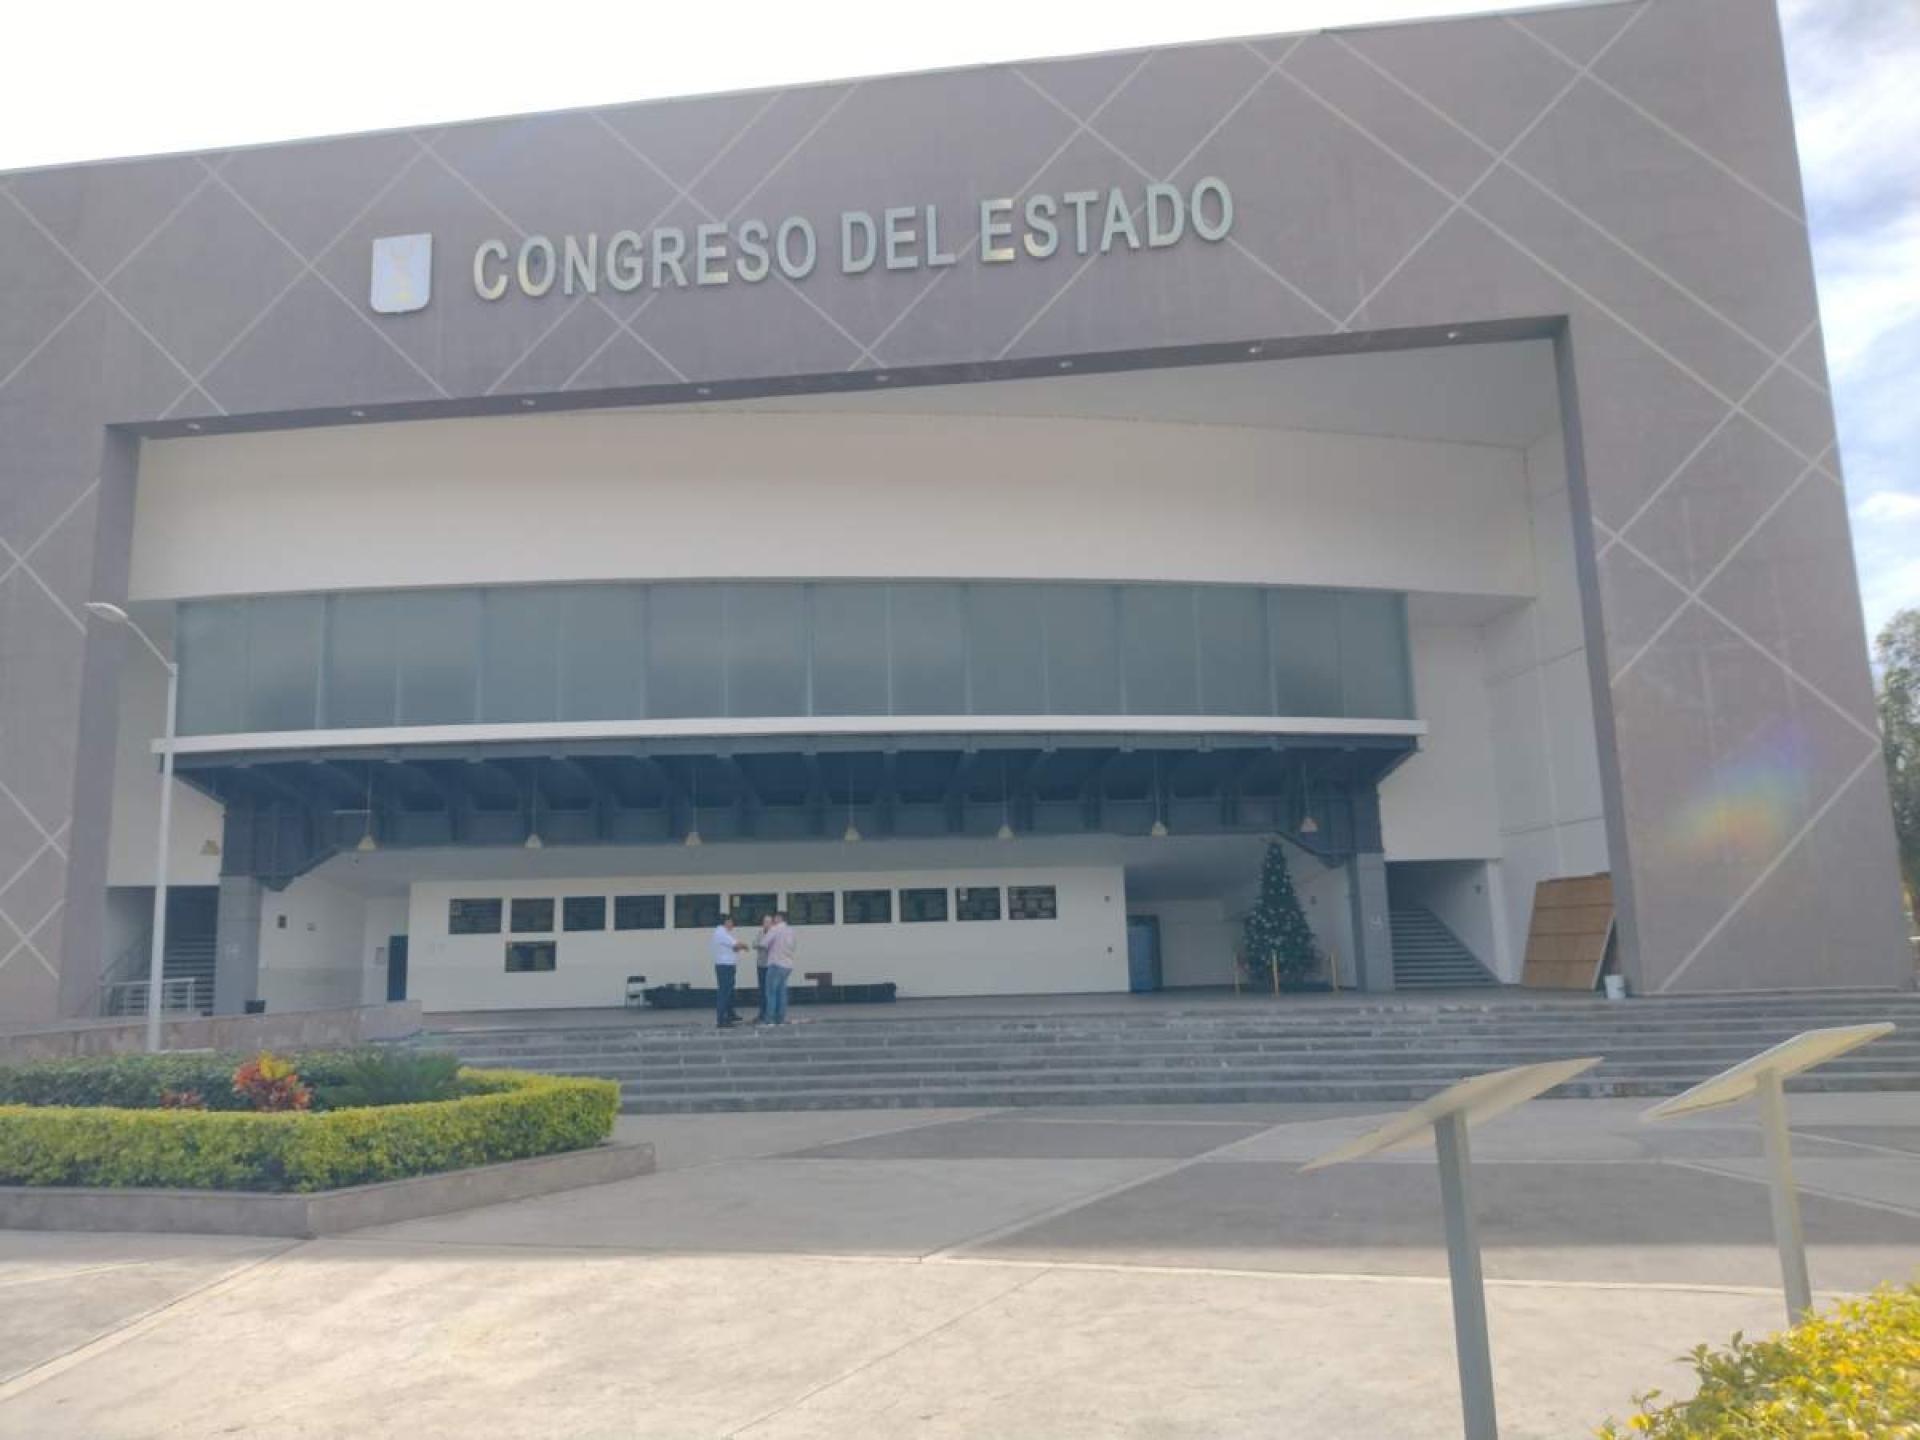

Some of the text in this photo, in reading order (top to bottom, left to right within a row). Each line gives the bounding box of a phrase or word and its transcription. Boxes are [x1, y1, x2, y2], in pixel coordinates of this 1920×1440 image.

[473, 175, 1234, 300] CONGRESO DEL ESTADO
